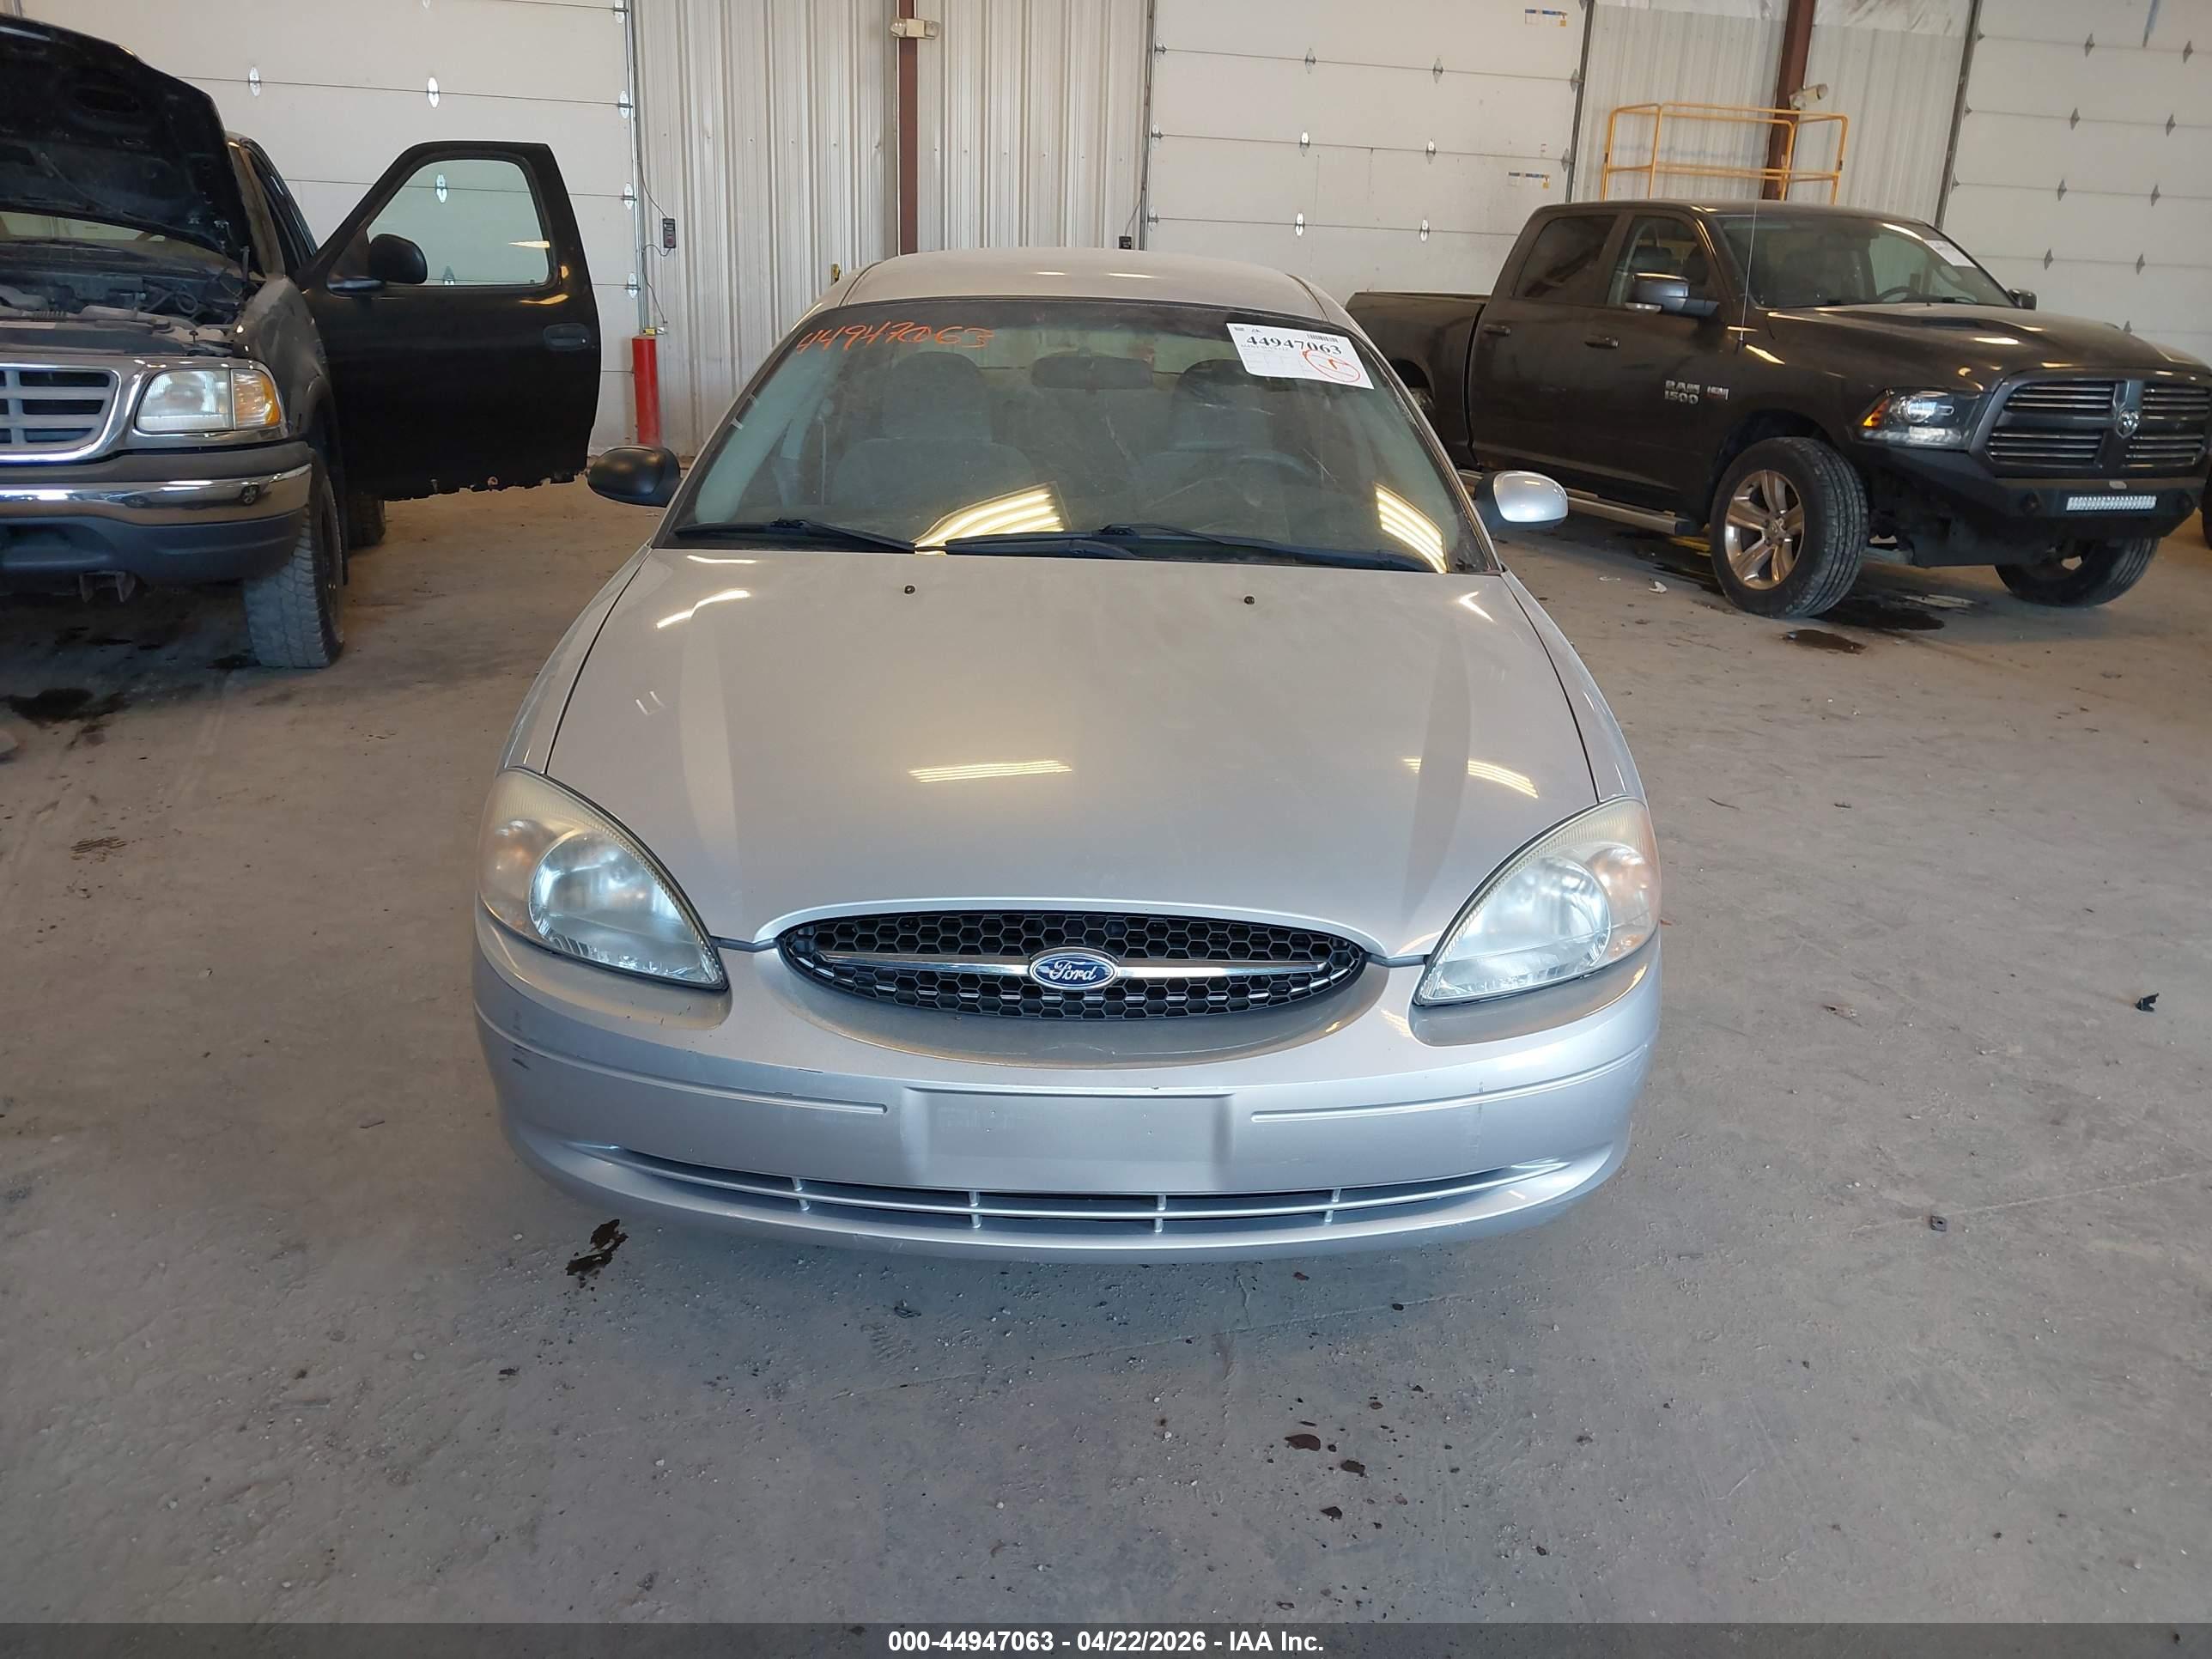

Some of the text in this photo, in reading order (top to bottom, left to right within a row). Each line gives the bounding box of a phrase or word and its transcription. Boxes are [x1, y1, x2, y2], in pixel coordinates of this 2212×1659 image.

[796, 321, 994, 356] 44947063
[1246, 336, 1342, 355] 44947063
[1665, 380, 1700, 394] RAM
[1664, 390, 1699, 404] 1500
[1048, 959, 1098, 981] Ford
